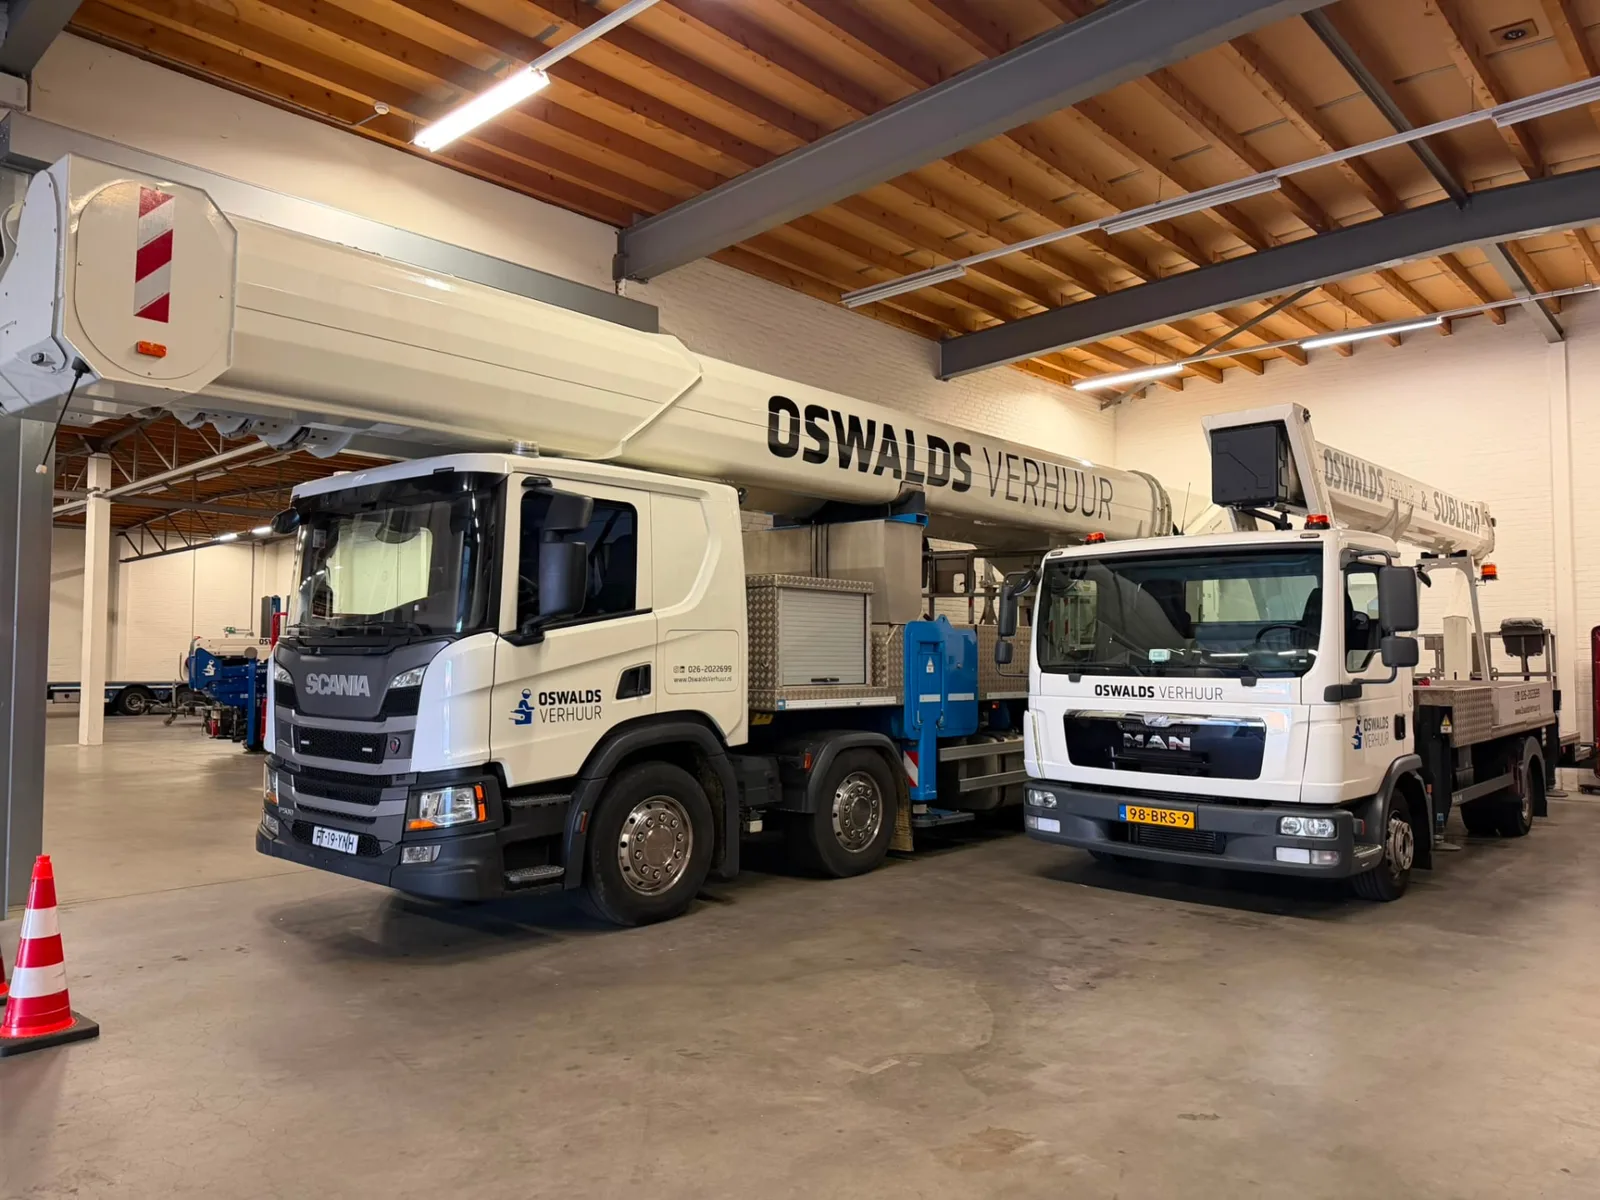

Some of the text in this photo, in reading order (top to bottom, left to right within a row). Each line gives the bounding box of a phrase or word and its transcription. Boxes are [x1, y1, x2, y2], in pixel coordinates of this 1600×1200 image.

[768, 395, 1113, 521] OSWALDS VERHUUR
[1323, 448, 1385, 503] OSWALDS
[687, 665, 732, 673] 026-2022699
[305, 673, 370, 697] SCANIA
[1094, 684, 1223, 700] OSWALDS VERHUUR
[538, 689, 602, 706] OSWALDS
[539, 705, 602, 723] VERHUUR
[1363, 716, 1389, 731] OSWALDS
[1123, 733, 1191, 751] MAN
[1129, 807, 1190, 825] 98-BRS-9
